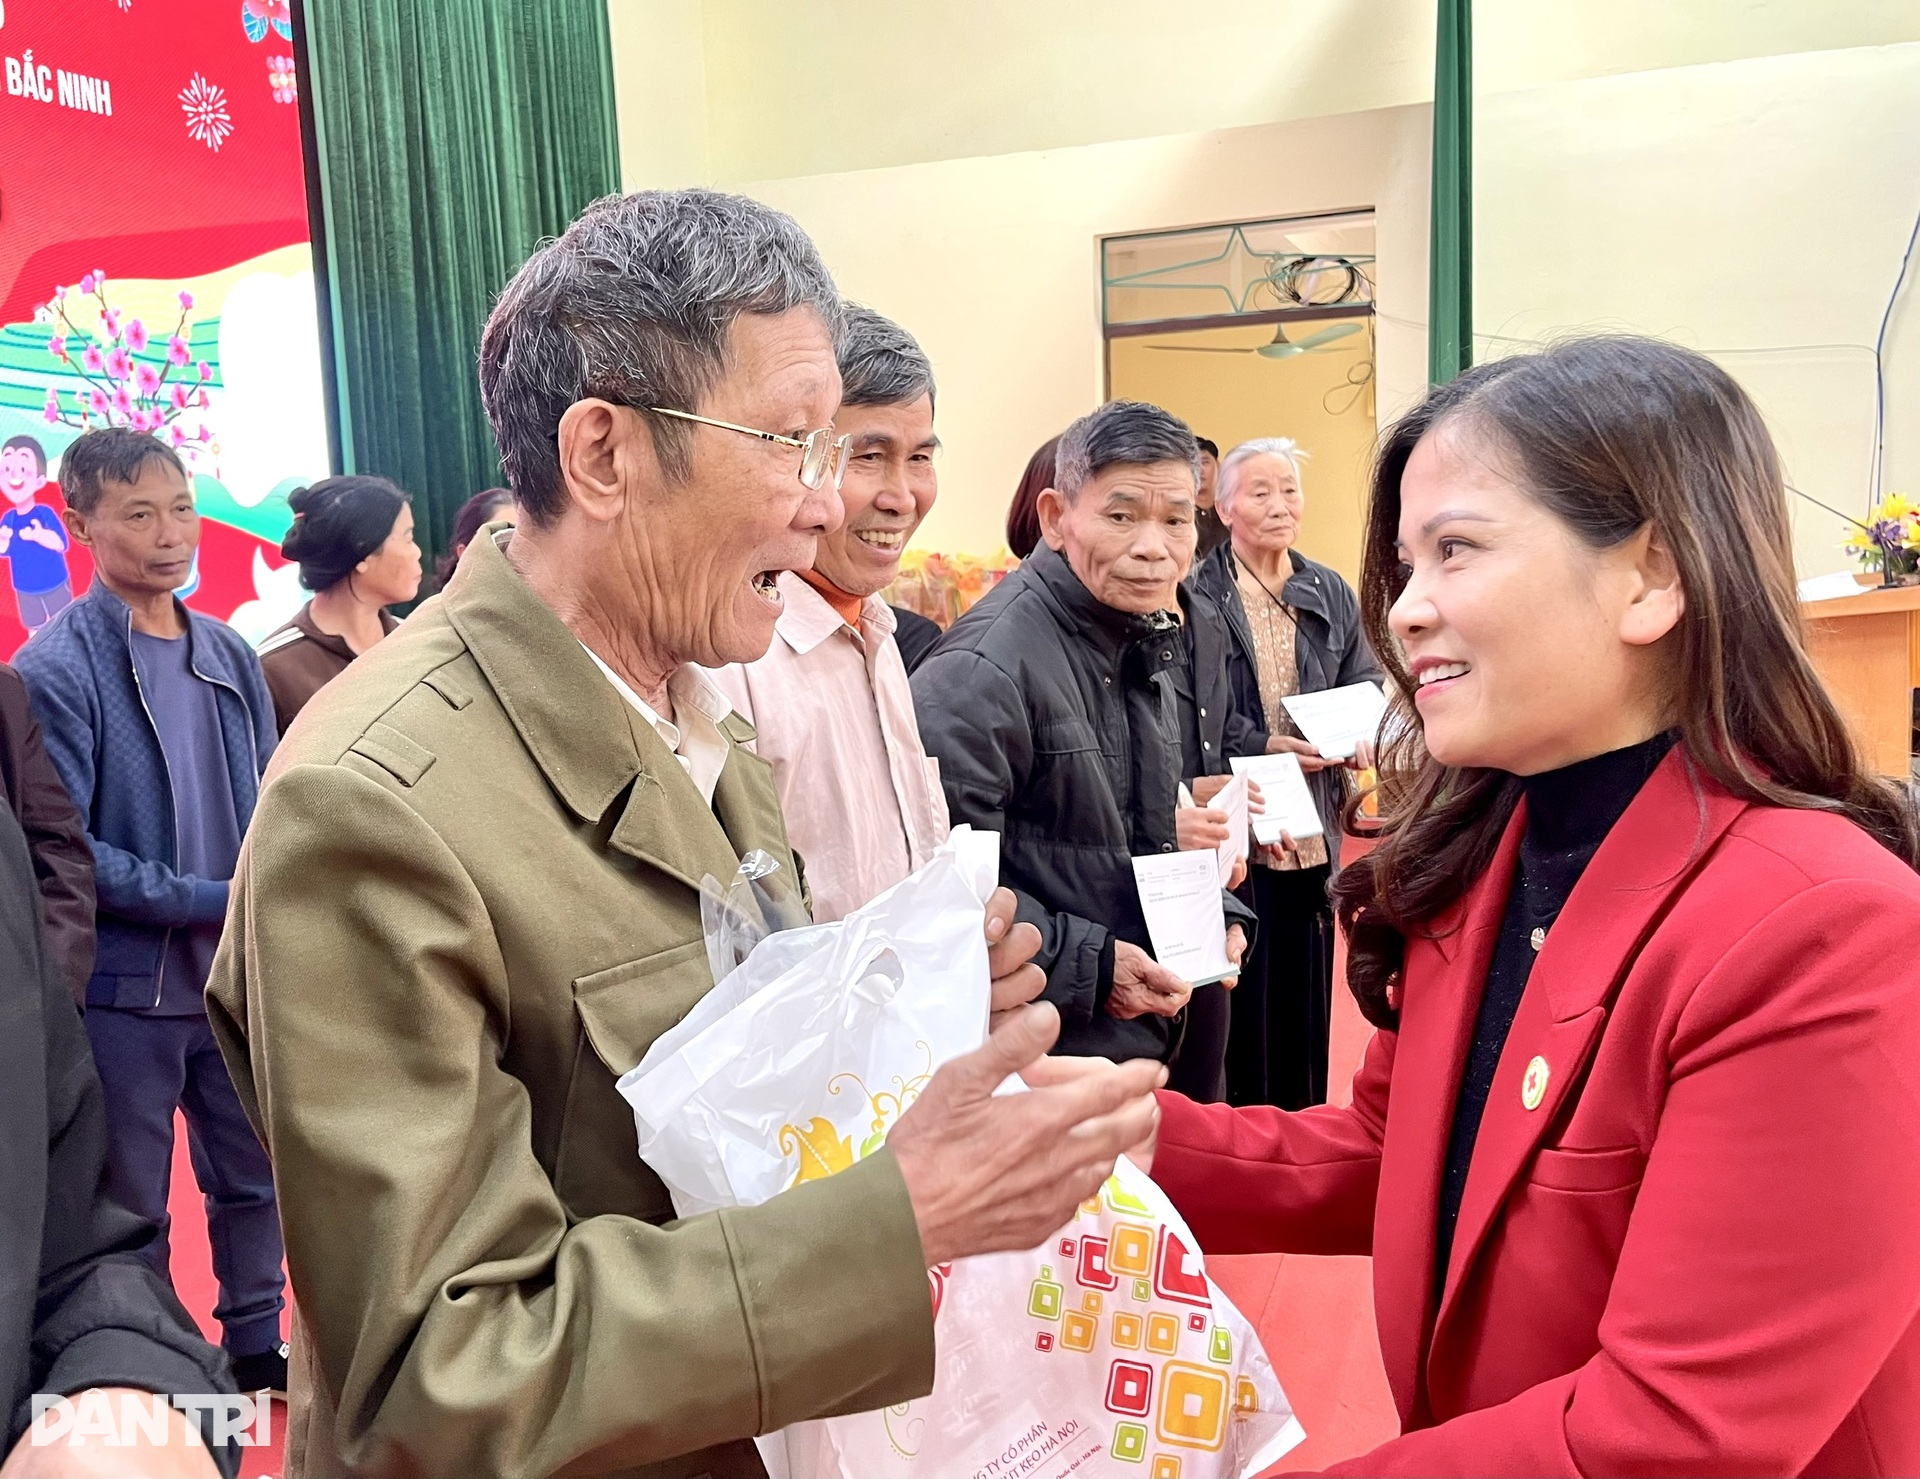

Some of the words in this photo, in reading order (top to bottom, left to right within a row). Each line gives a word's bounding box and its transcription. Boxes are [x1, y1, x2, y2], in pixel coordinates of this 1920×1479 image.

[5, 48, 54, 104] BẮC
[56, 69, 113, 116] NINH
[985, 1458, 1000, 1475] TY
[1019, 1449, 1041, 1473] KẸO
[1040, 1435, 1059, 1455] HÀ
[1057, 1419, 1079, 1442] NỘI
